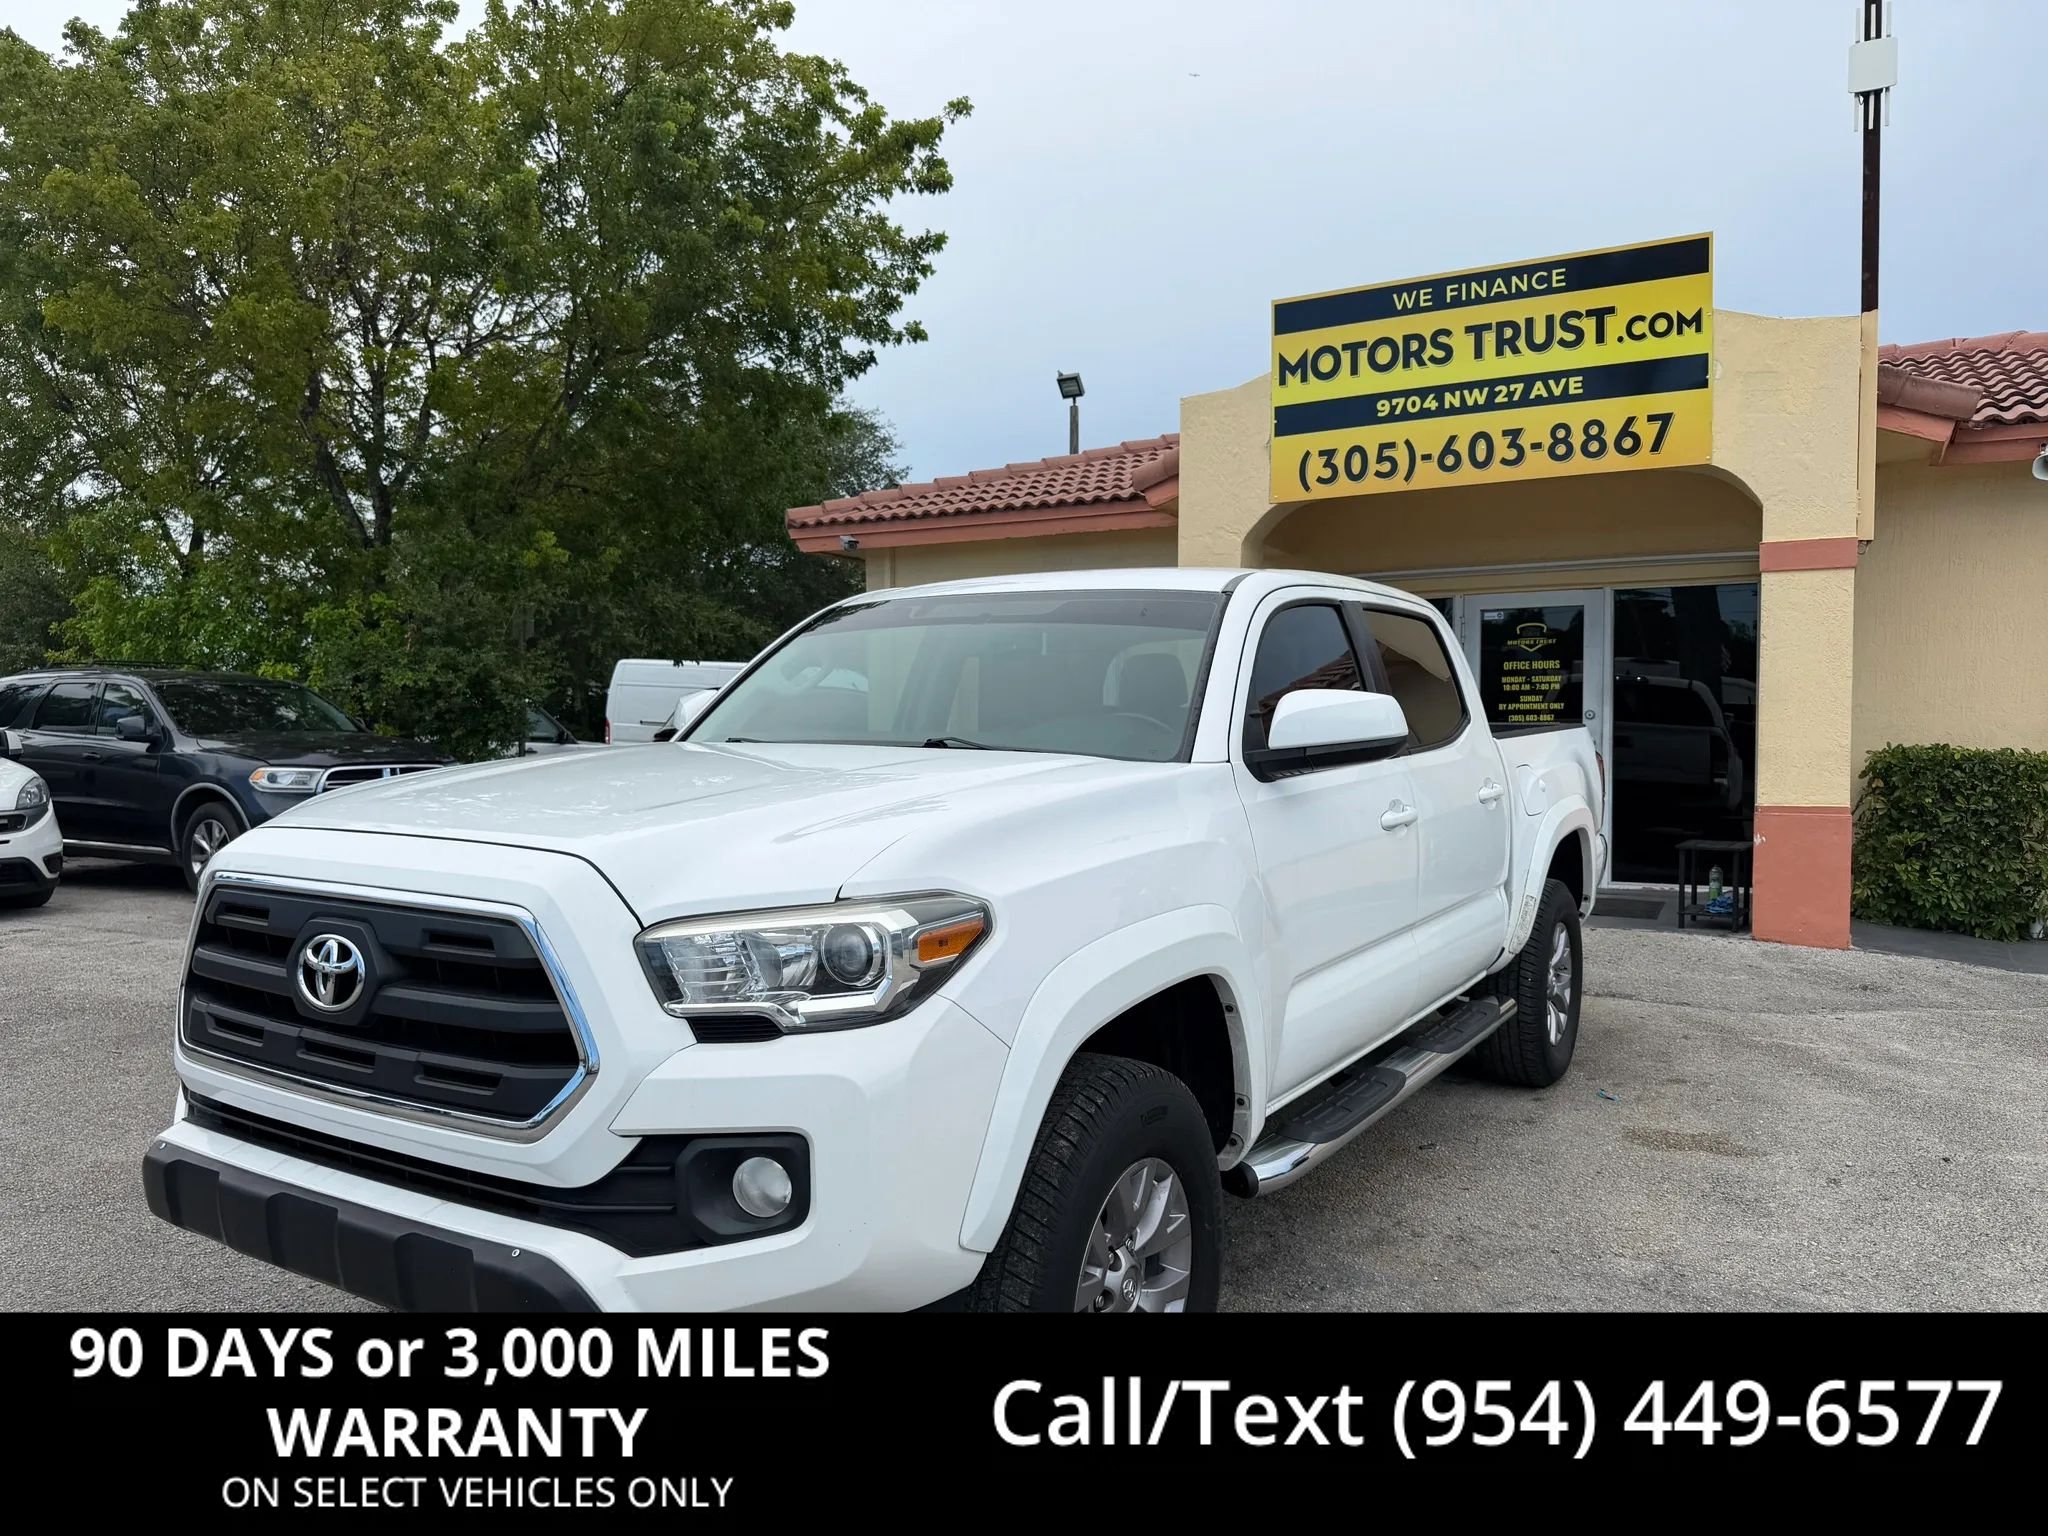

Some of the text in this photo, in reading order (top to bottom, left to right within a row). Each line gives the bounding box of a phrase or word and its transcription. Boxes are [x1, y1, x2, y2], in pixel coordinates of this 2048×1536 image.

[1393, 268, 1567, 311] WE FINANCE
[1278, 327, 1454, 387] MOTORS
[1376, 376, 1585, 418] 9704 NW 27 AVE
[1298, 411, 1675, 493] (305)-603-8867
[1503, 660, 1560, 670] OFFICE HOURS
